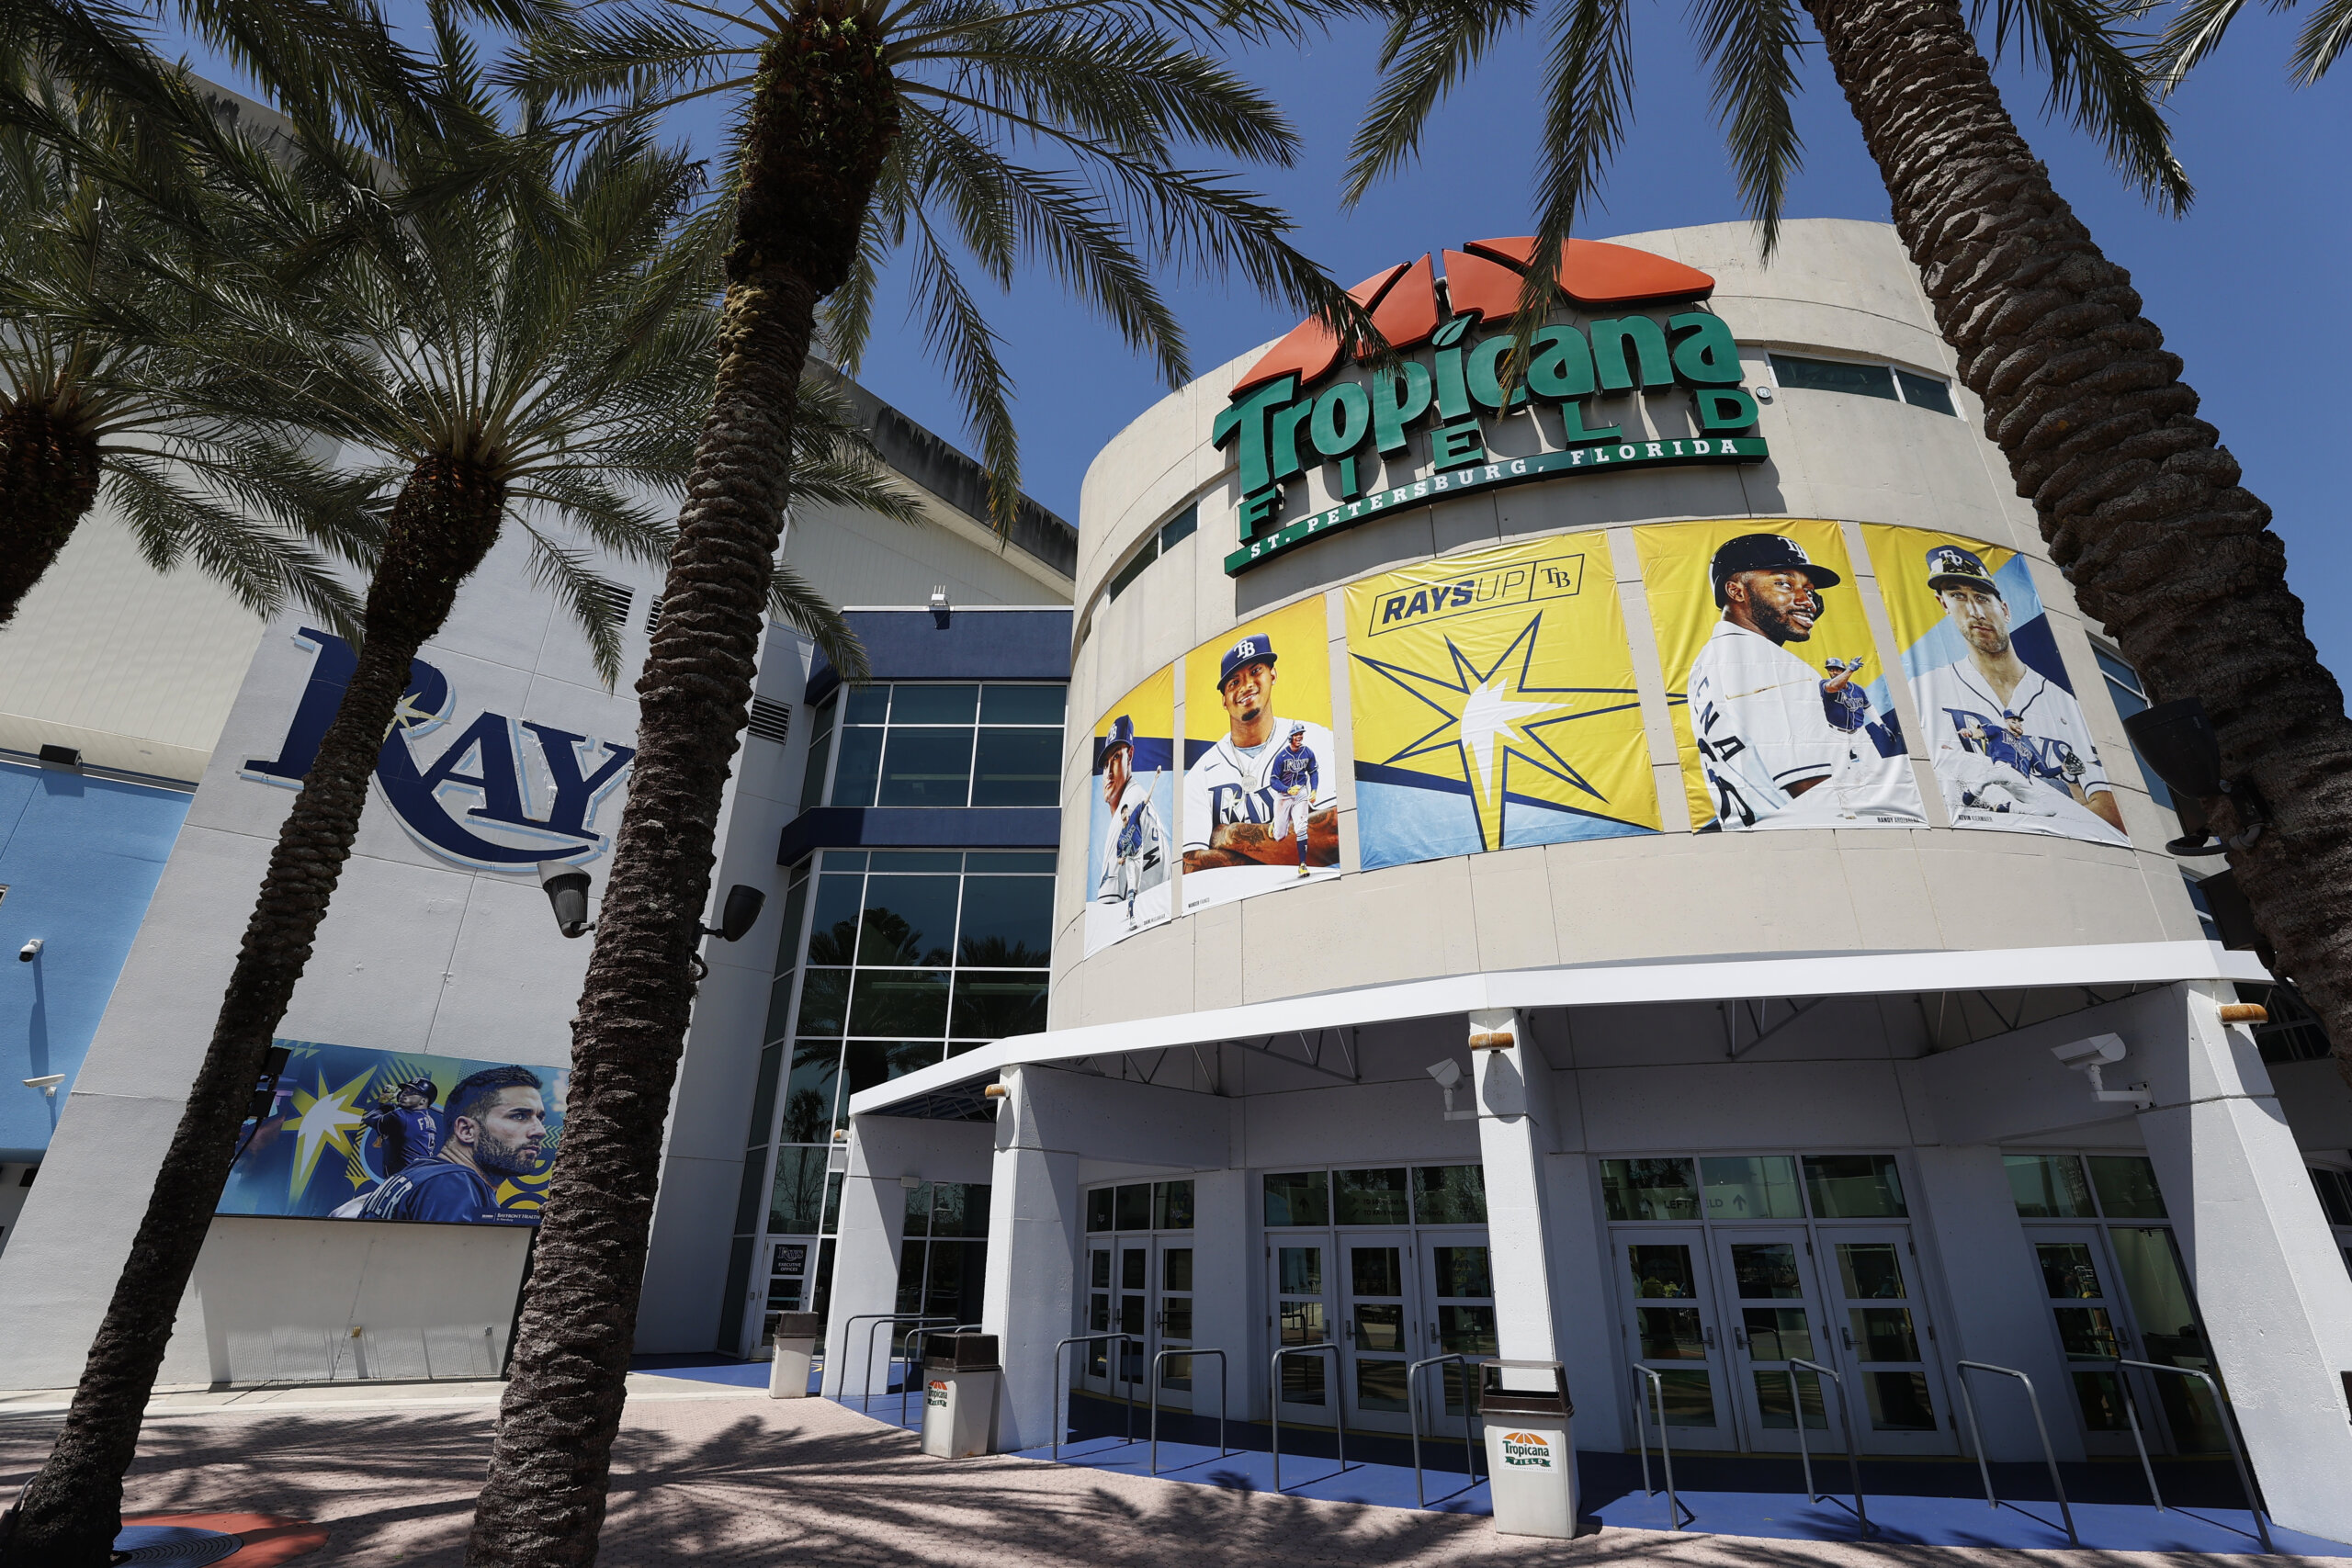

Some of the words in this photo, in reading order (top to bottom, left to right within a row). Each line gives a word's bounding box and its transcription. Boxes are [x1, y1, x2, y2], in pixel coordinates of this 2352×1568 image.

[1213, 311, 1743, 497] Tropicana
[1238, 389, 1759, 546] FIELD
[1250, 532, 1291, 560] ST.
[1306, 458, 1546, 534] PETERSBURG,
[1571, 437, 1739, 466] FLORIDA
[1541, 566, 1571, 589] TB
[1234, 639, 1256, 660] TB
[236, 626, 637, 871] RAY
[1283, 758, 1309, 774] RAYS
[1208, 783, 1275, 825] RAY
[1502, 1440, 1550, 1457] Tropicana
